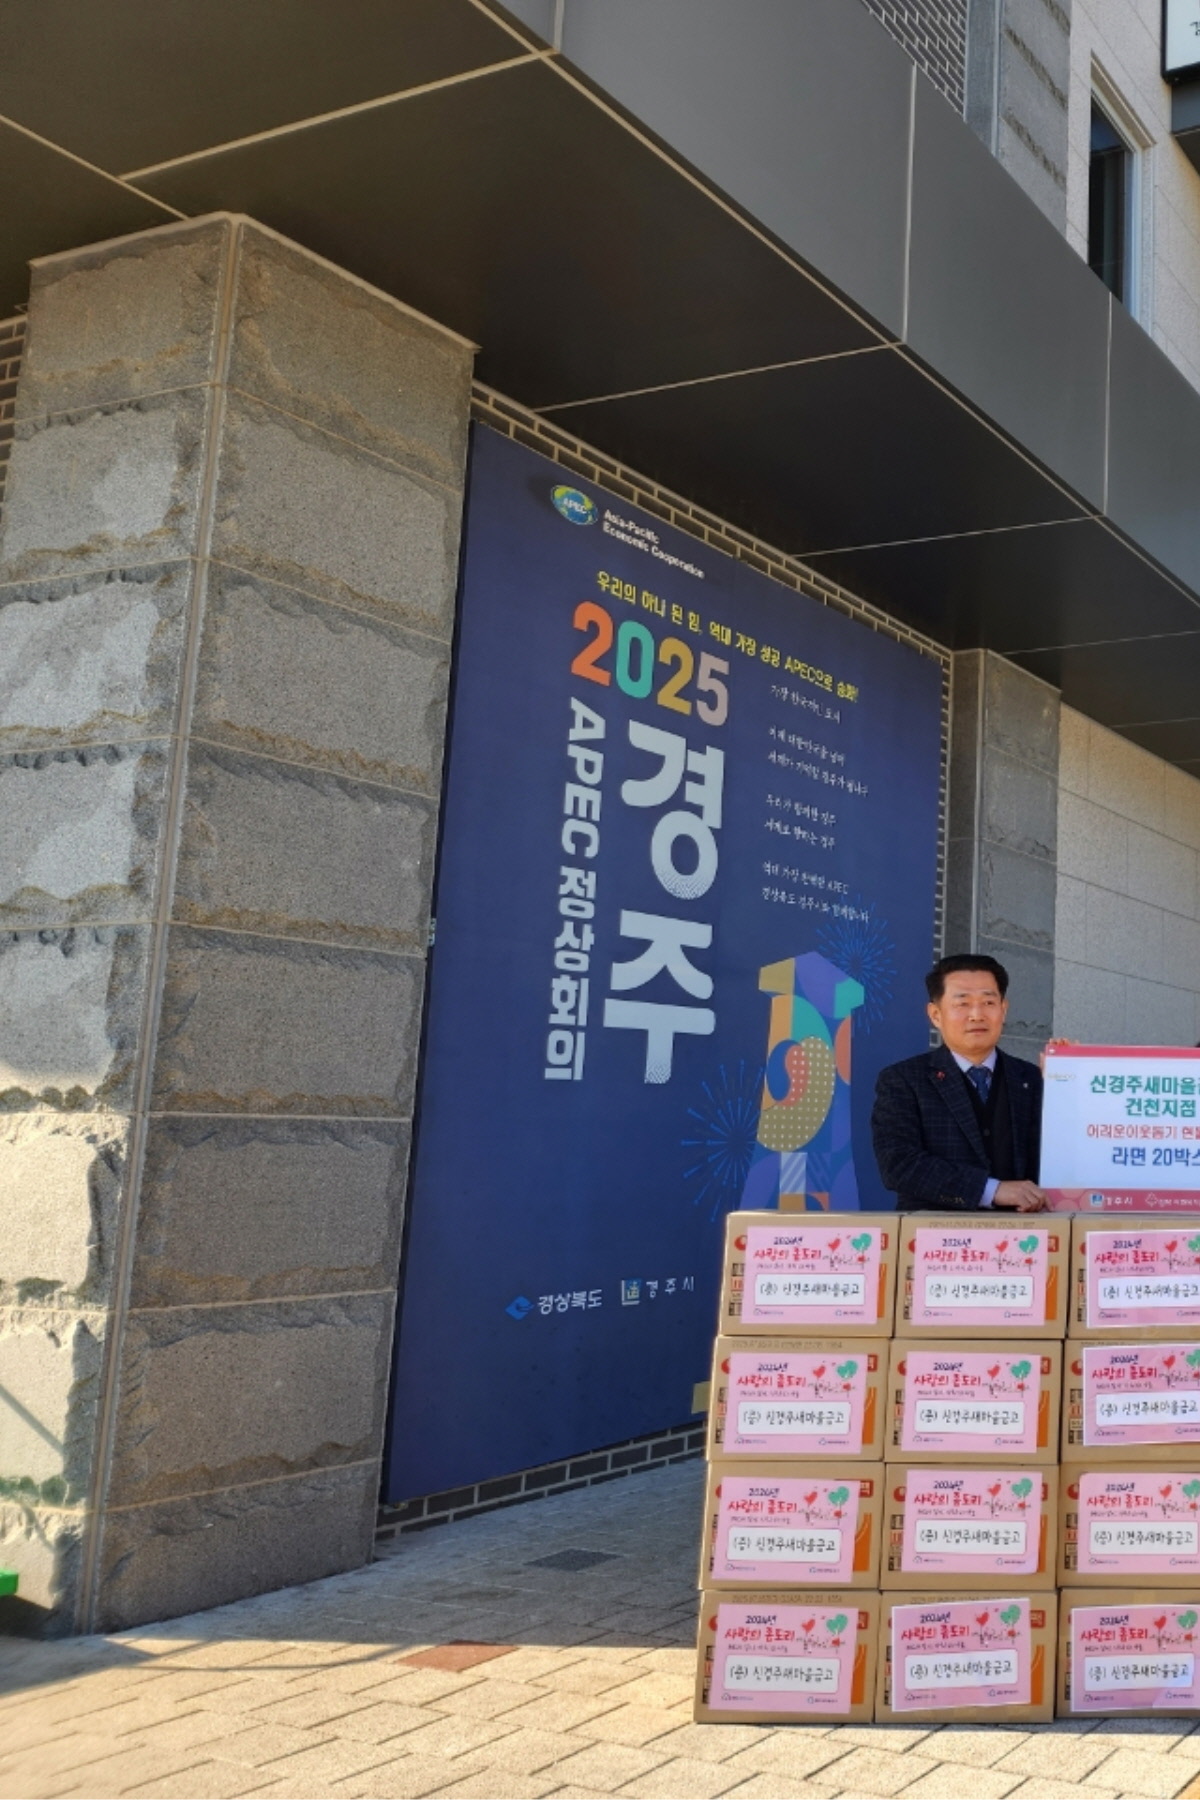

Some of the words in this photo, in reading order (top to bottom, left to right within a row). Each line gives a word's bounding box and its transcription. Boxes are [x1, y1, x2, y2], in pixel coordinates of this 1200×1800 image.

[562, 497, 587, 514] APEC
[604, 509, 660, 544] Asia-Pacific
[603, 521, 649, 552] Economic
[651, 545, 705, 579] Cooperation
[597, 571, 636, 605] 우리의
[642, 590, 666, 617] 하나
[671, 603, 683, 625] 된
[709, 621, 732, 646] 역대
[735, 632, 757, 657] 가장
[760, 645, 780, 668] 성공
[784, 656, 833, 692] APEC으로
[571, 600, 730, 726] 2025
[560, 696, 606, 860] APEC
[603, 718, 726, 1084] 경주
[544, 864, 596, 1081] 정상회의
[1125, 1098, 1197, 1118] 건천지점
[1112, 1146, 1146, 1167] 라면
[537, 1289, 602, 1315] 경상북도
[646, 1276, 694, 1298] 경주시
